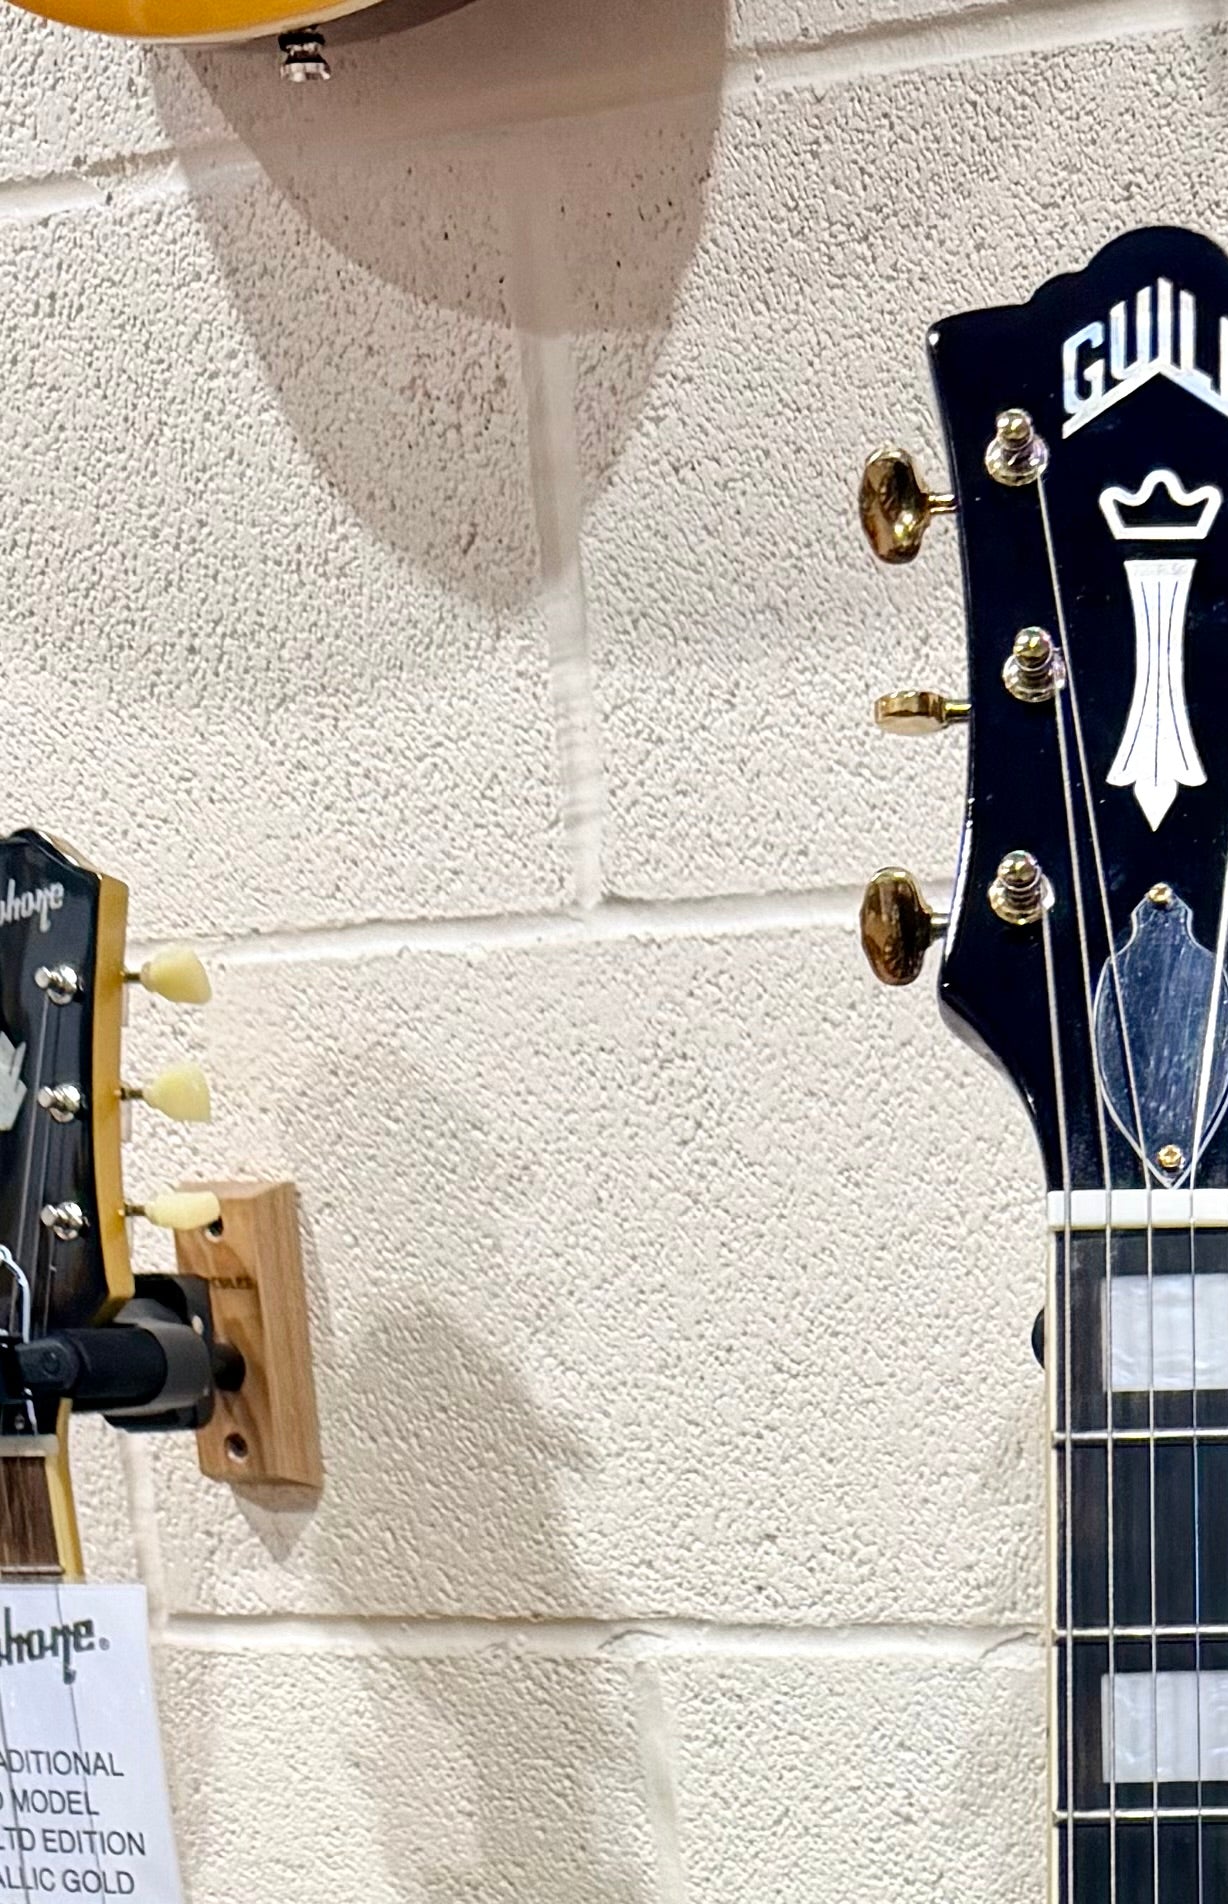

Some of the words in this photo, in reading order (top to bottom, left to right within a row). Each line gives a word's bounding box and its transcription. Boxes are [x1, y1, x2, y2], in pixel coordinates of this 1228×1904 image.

[0, 878, 65, 932] hone
[12, 1788, 100, 1815] MODEL
[42, 1829, 146, 1856] EDITION
[62, 1869, 135, 1895] GOLD
